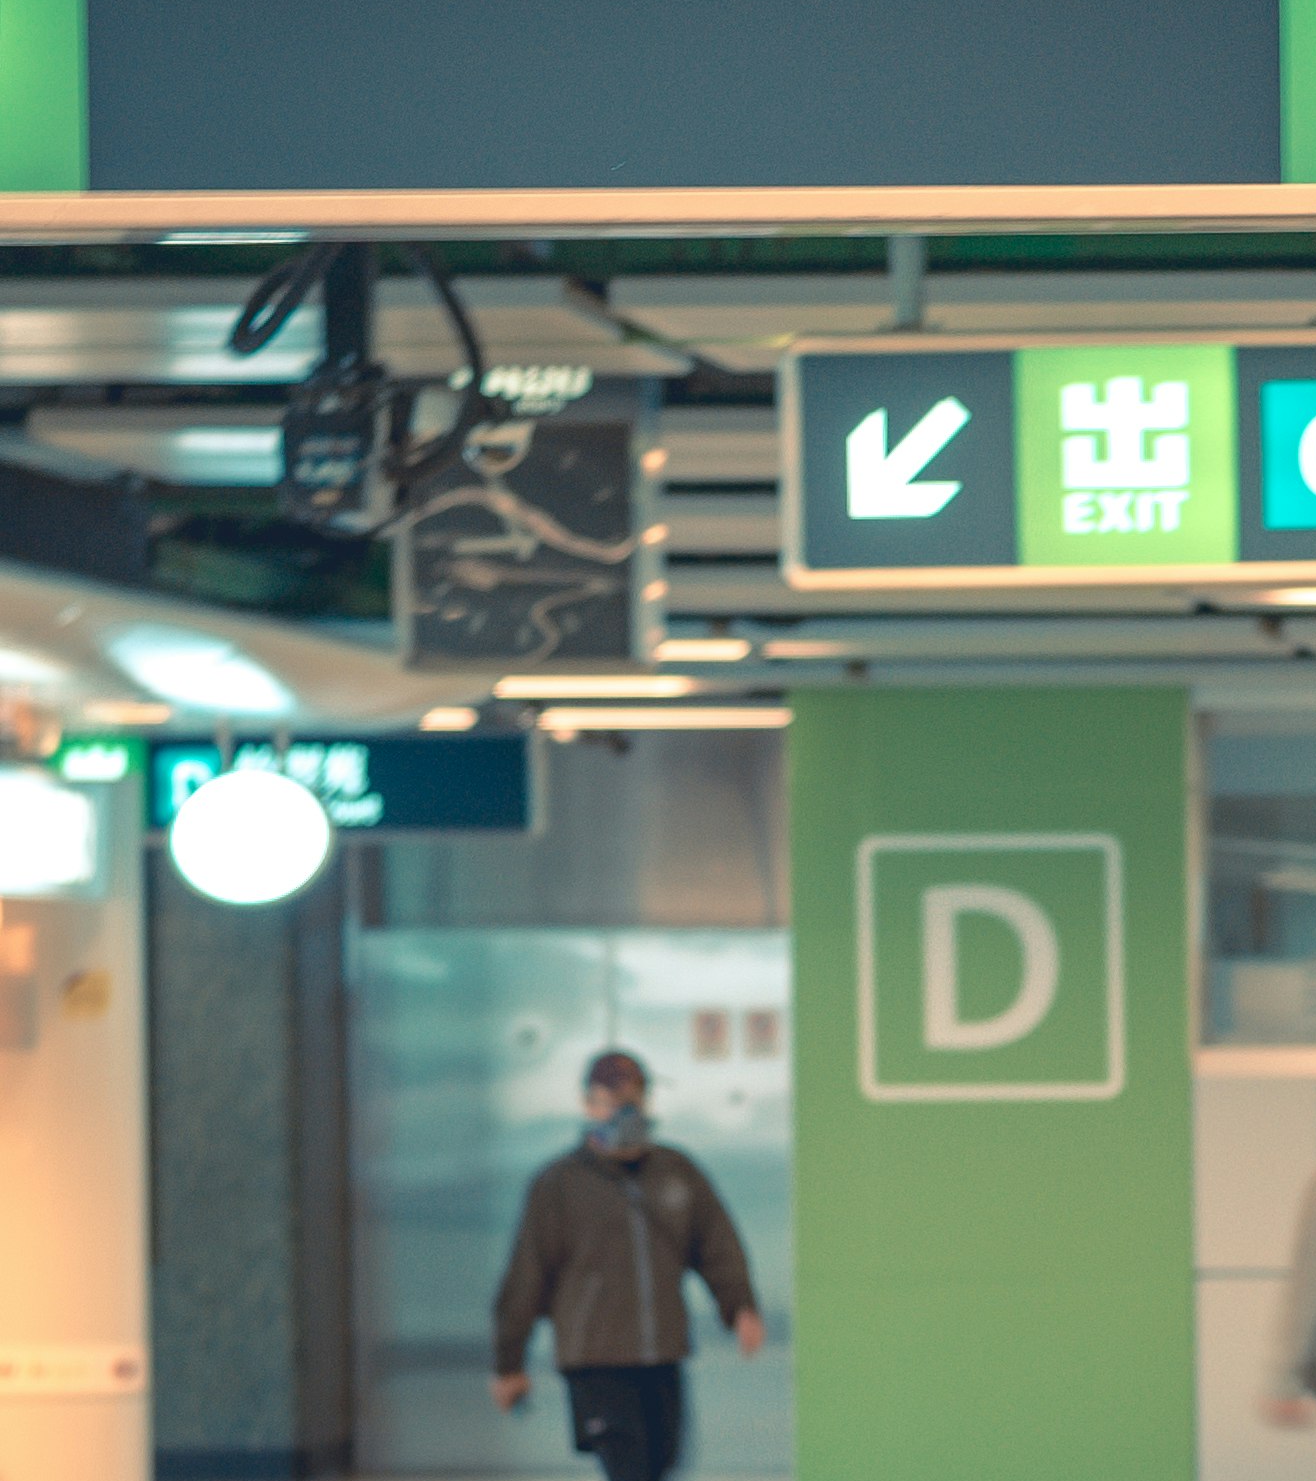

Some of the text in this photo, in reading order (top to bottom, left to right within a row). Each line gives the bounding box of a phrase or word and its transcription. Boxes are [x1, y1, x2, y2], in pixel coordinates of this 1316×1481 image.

[1059, 376, 1190, 488] 出
[1062, 491, 1189, 534] EXIT
[923, 884, 1060, 1051] D
